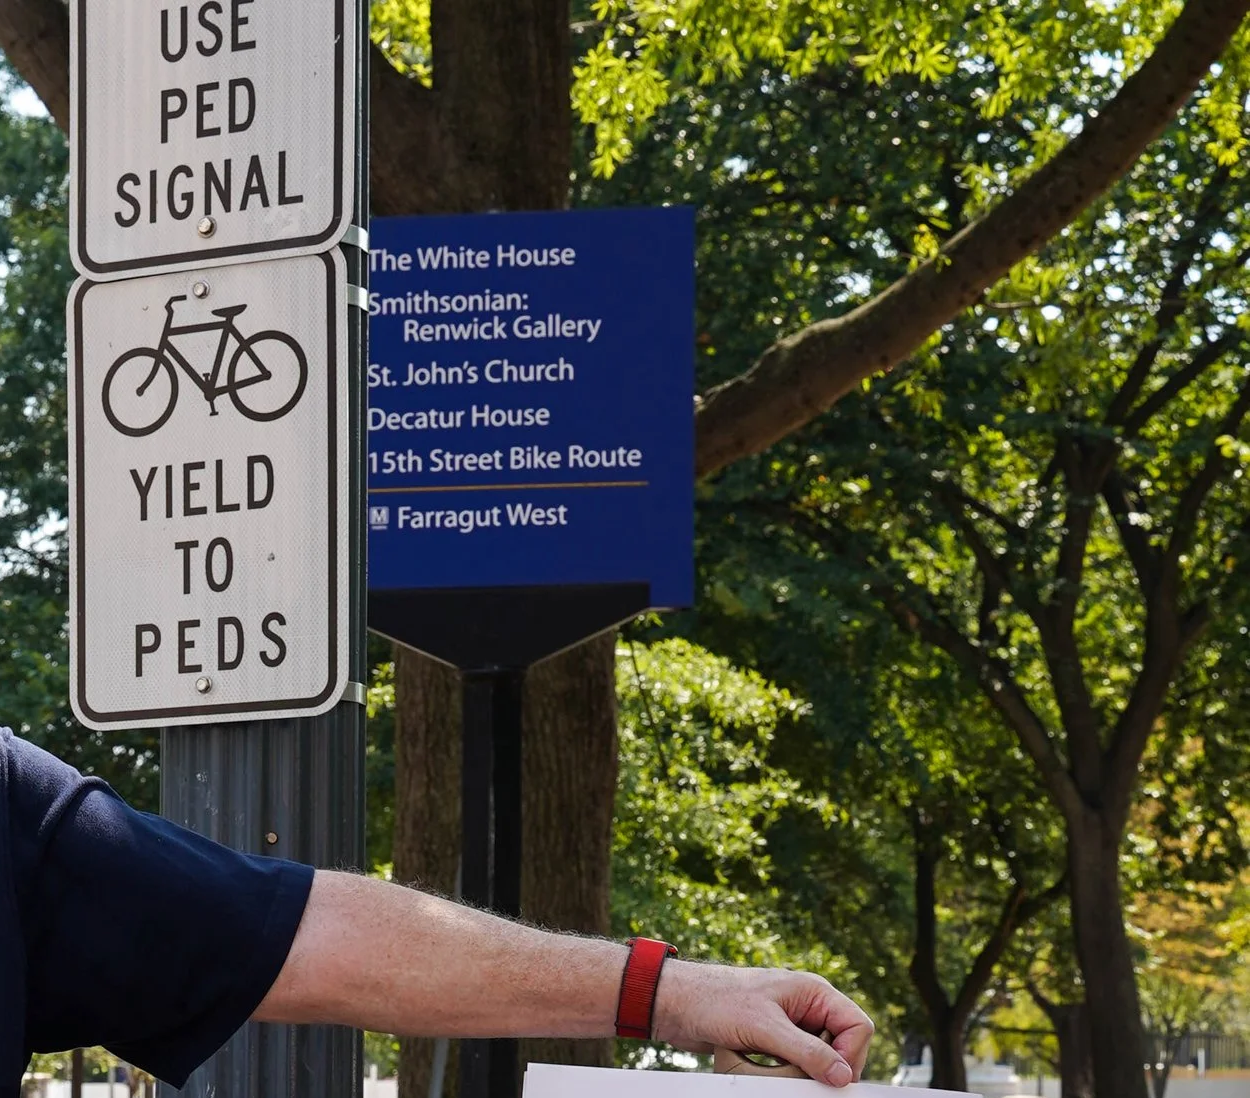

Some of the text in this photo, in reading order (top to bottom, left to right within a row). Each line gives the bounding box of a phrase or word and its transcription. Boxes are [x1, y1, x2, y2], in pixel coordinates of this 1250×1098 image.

[161, 0, 256, 62] USE
[161, 78, 255, 143] PED
[115, 151, 304, 228] SIGNAL
[369, 245, 575, 271] The White House
[369, 289, 528, 315] Smithsonian:
[405, 314, 601, 342] Renwick Gallery
[368, 358, 573, 387] St. John's Church
[367, 405, 550, 431] Decatur House
[370, 446, 641, 473] 15th Street Bike Route
[130, 455, 274, 521] YIELD
[399, 507, 500, 533] Farragut
[507, 504, 567, 525] West
[175, 537, 233, 594] TO
[136, 612, 286, 677] PEDS
